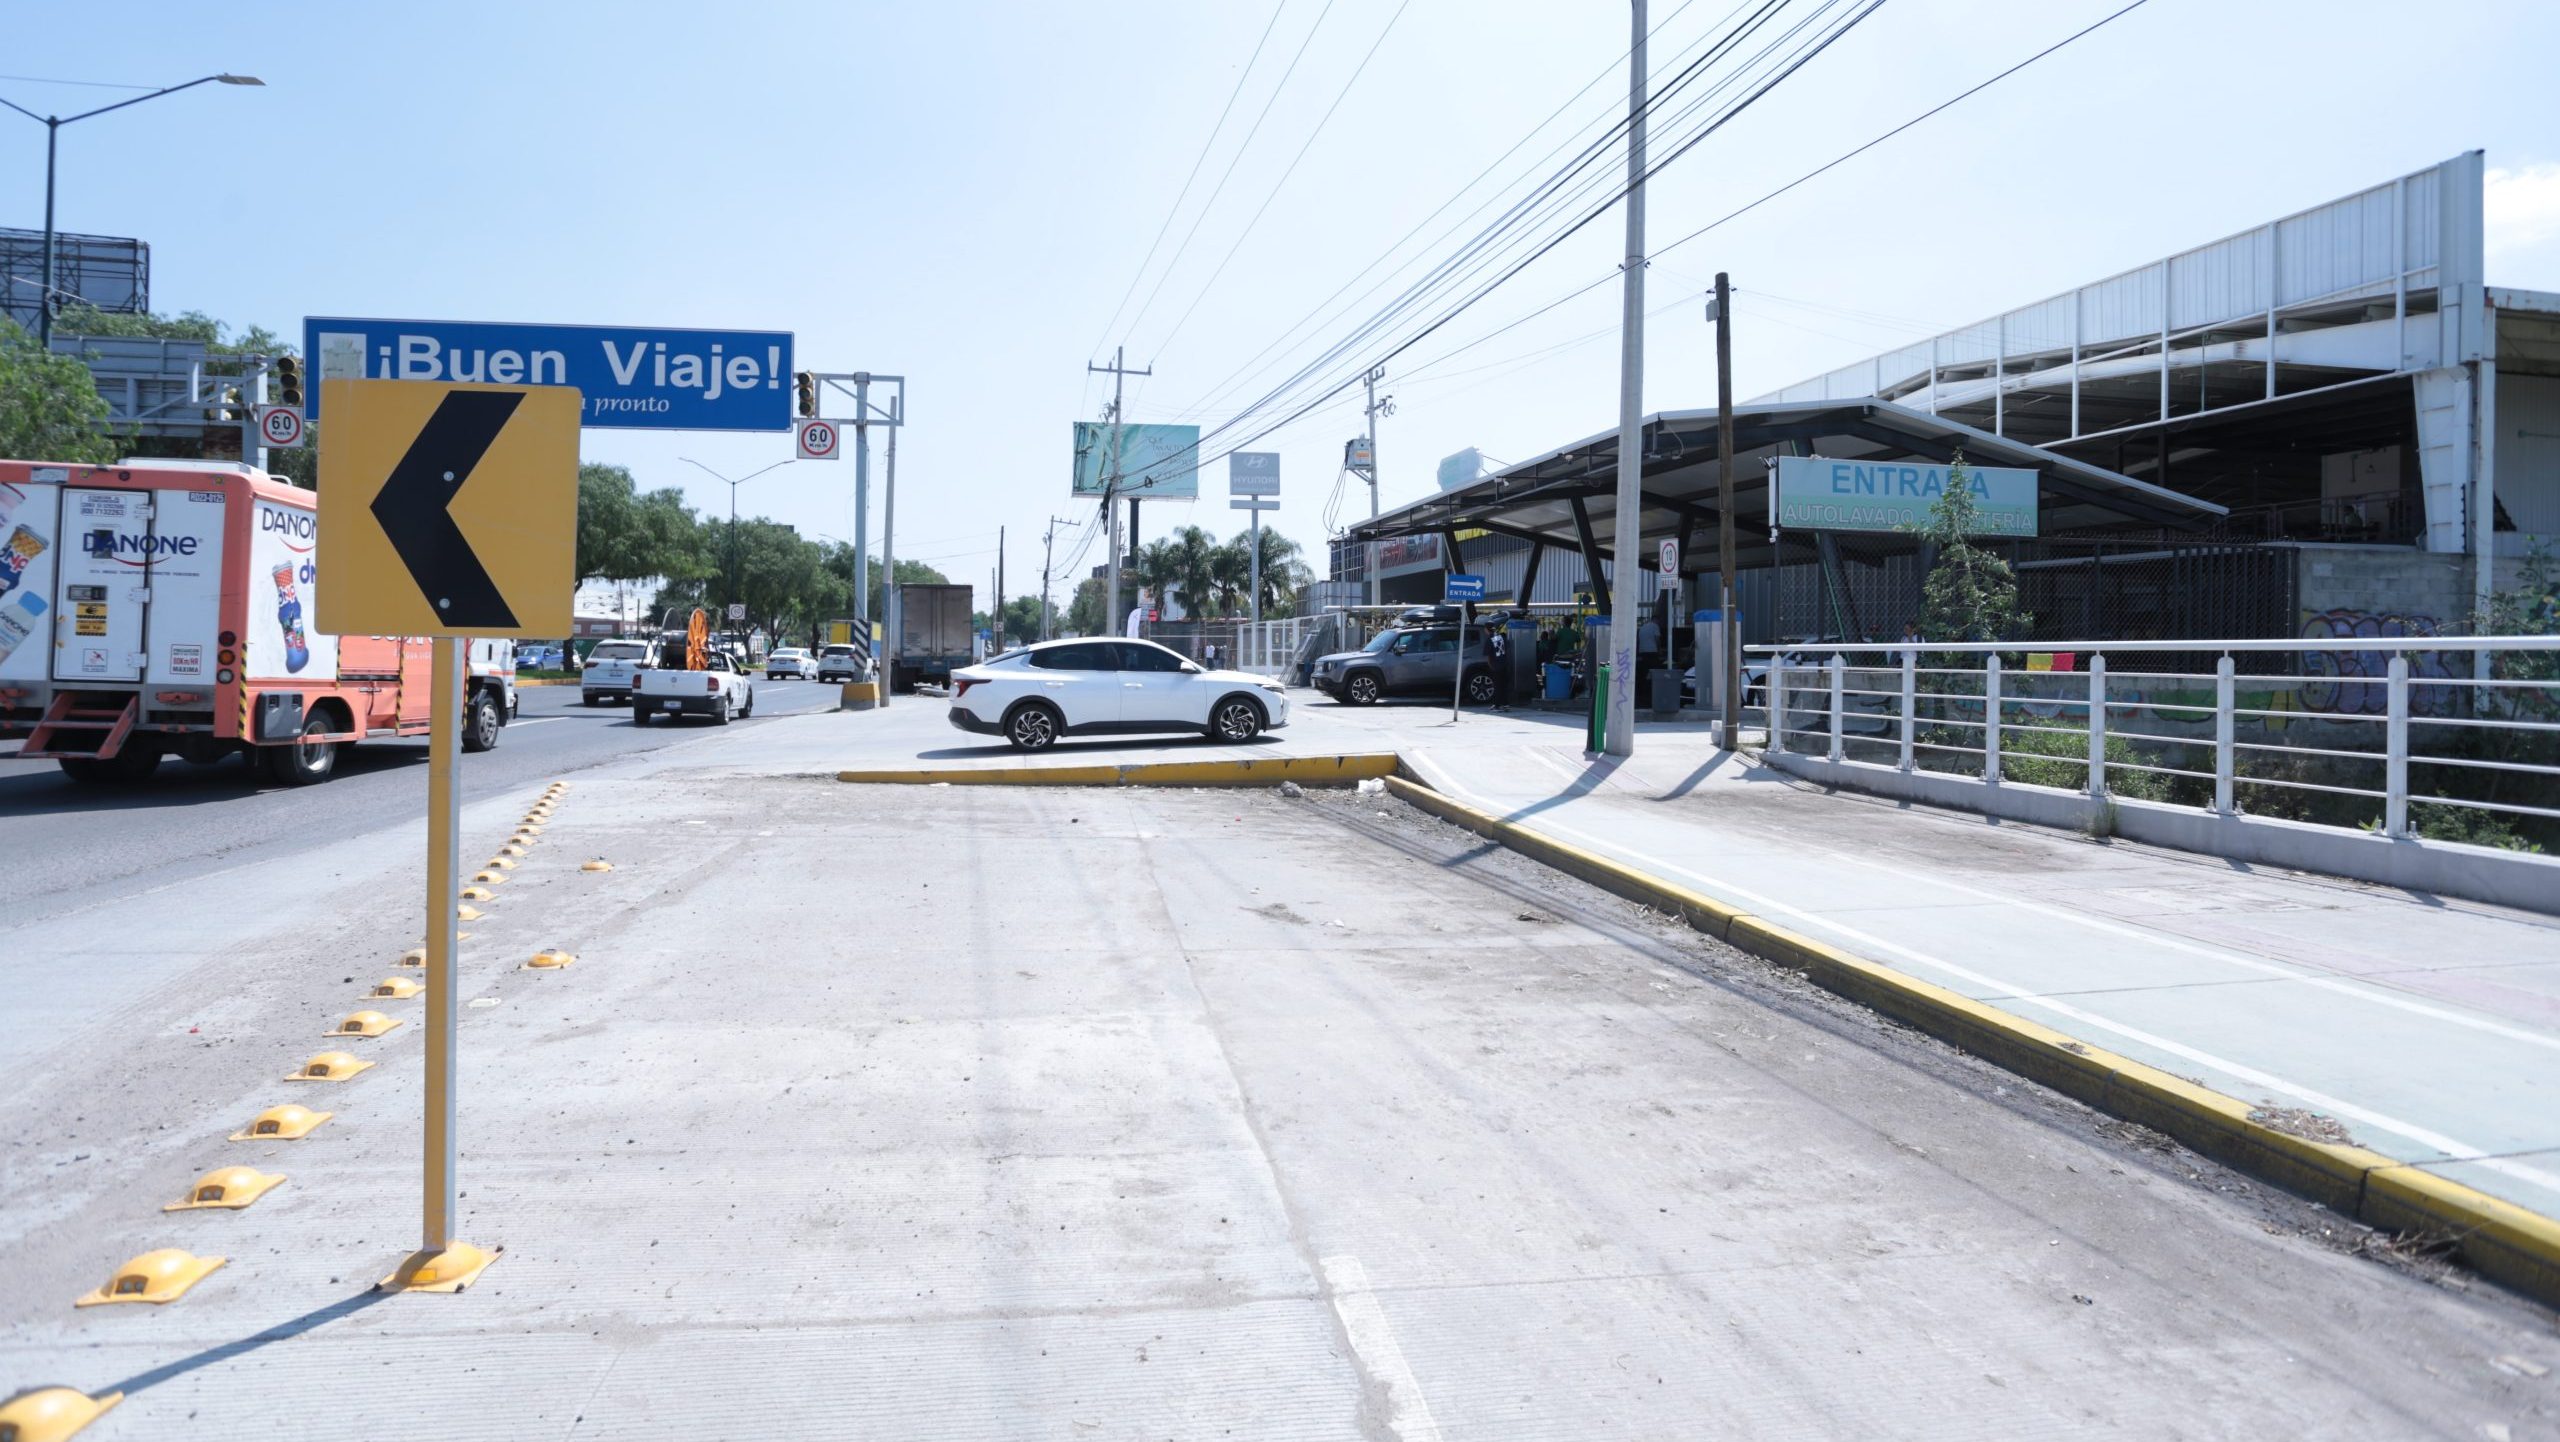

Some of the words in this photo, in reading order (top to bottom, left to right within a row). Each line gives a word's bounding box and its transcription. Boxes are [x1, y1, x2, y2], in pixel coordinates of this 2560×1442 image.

[379, 334, 566, 384] ¡Buen
[601, 340, 780, 400] Viaje!
[594, 397, 670, 416] pronto
[271, 415, 292, 430] 60
[809, 428, 828, 443] 60
[1232, 476, 1278, 485] HYUNDAI
[1784, 503, 1915, 527] AUTOLAVADO
[1449, 589, 1481, 597] ENTRADA
